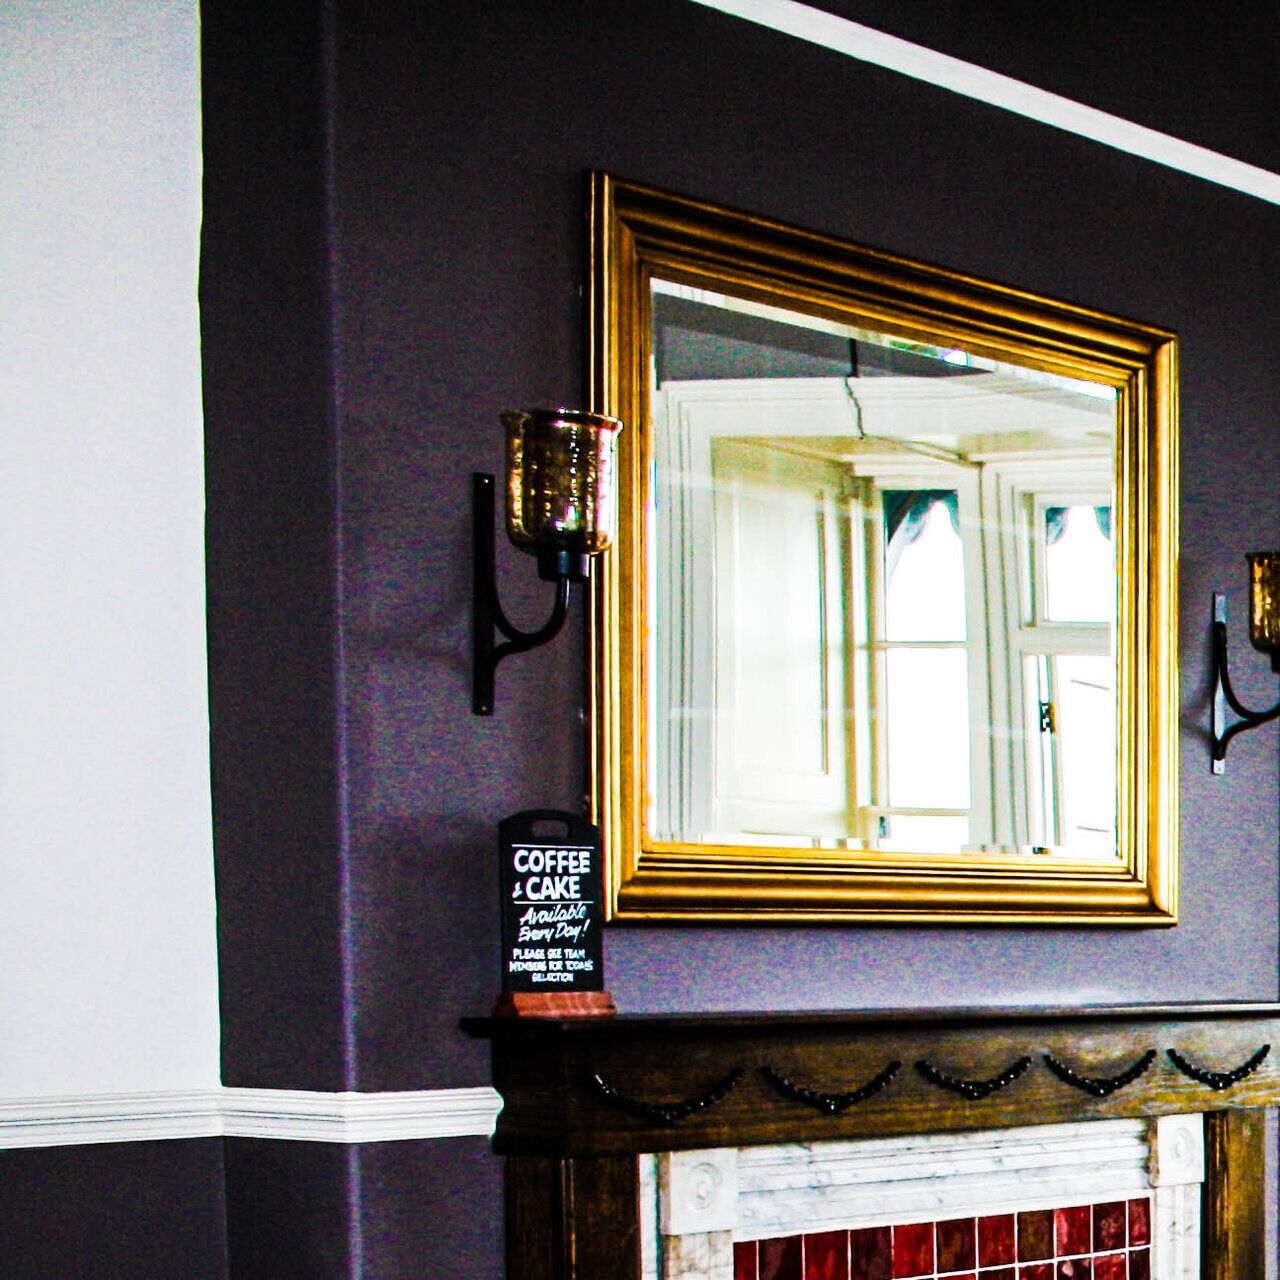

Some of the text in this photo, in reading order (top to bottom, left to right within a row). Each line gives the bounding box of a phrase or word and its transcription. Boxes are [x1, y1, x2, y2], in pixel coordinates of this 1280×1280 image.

[514, 849, 591, 874] COFFEE
[526, 875, 581, 900] CAKE
[520, 902, 587, 925] Available
[518, 918, 591, 943] Every Day!
[513, 948, 546, 959] PLEASE
